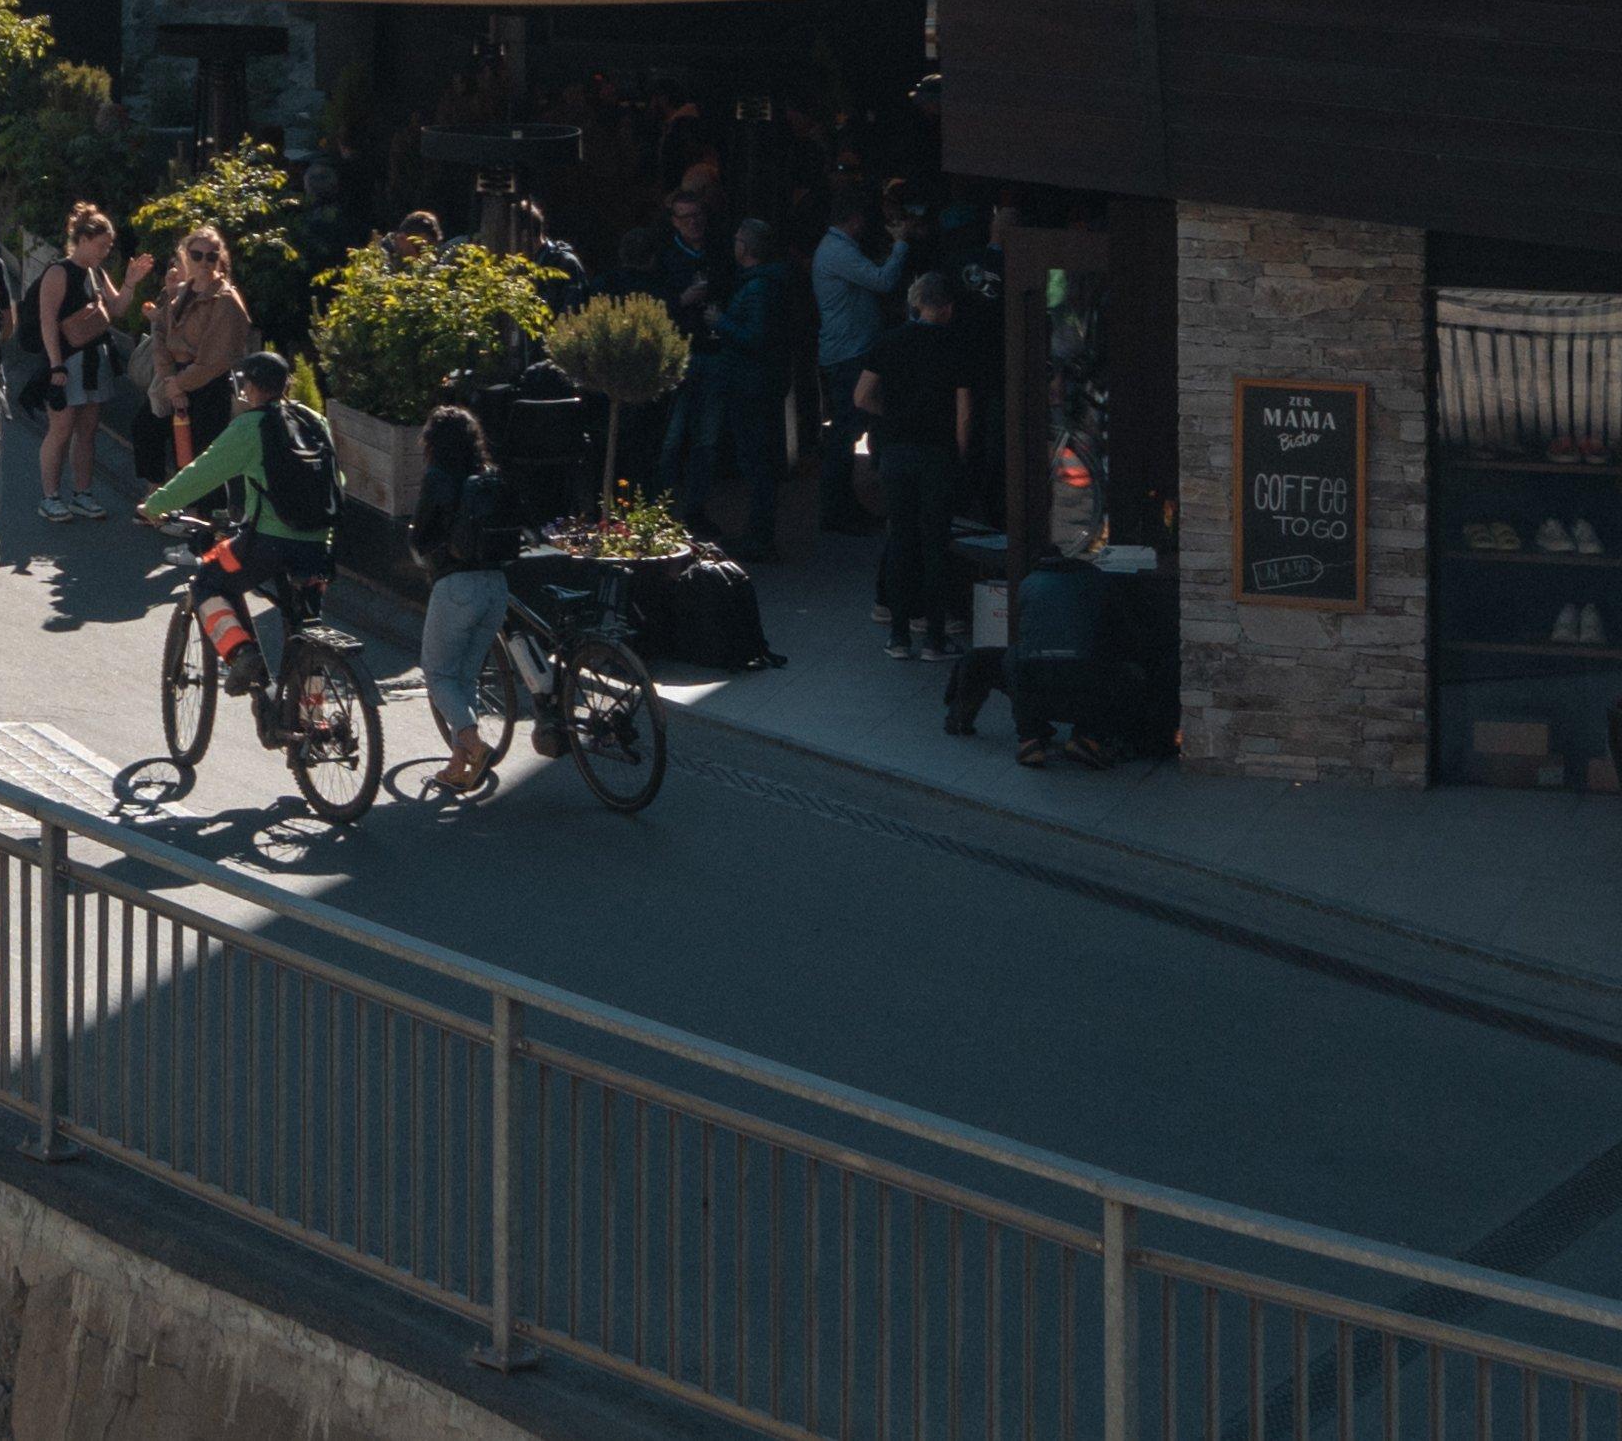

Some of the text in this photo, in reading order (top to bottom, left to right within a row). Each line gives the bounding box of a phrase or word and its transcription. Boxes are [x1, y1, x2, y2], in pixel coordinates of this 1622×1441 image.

[1288, 396, 1312, 407] ZER
[1262, 407, 1336, 430] MAMA
[1278, 431, 1321, 451] Bistro
